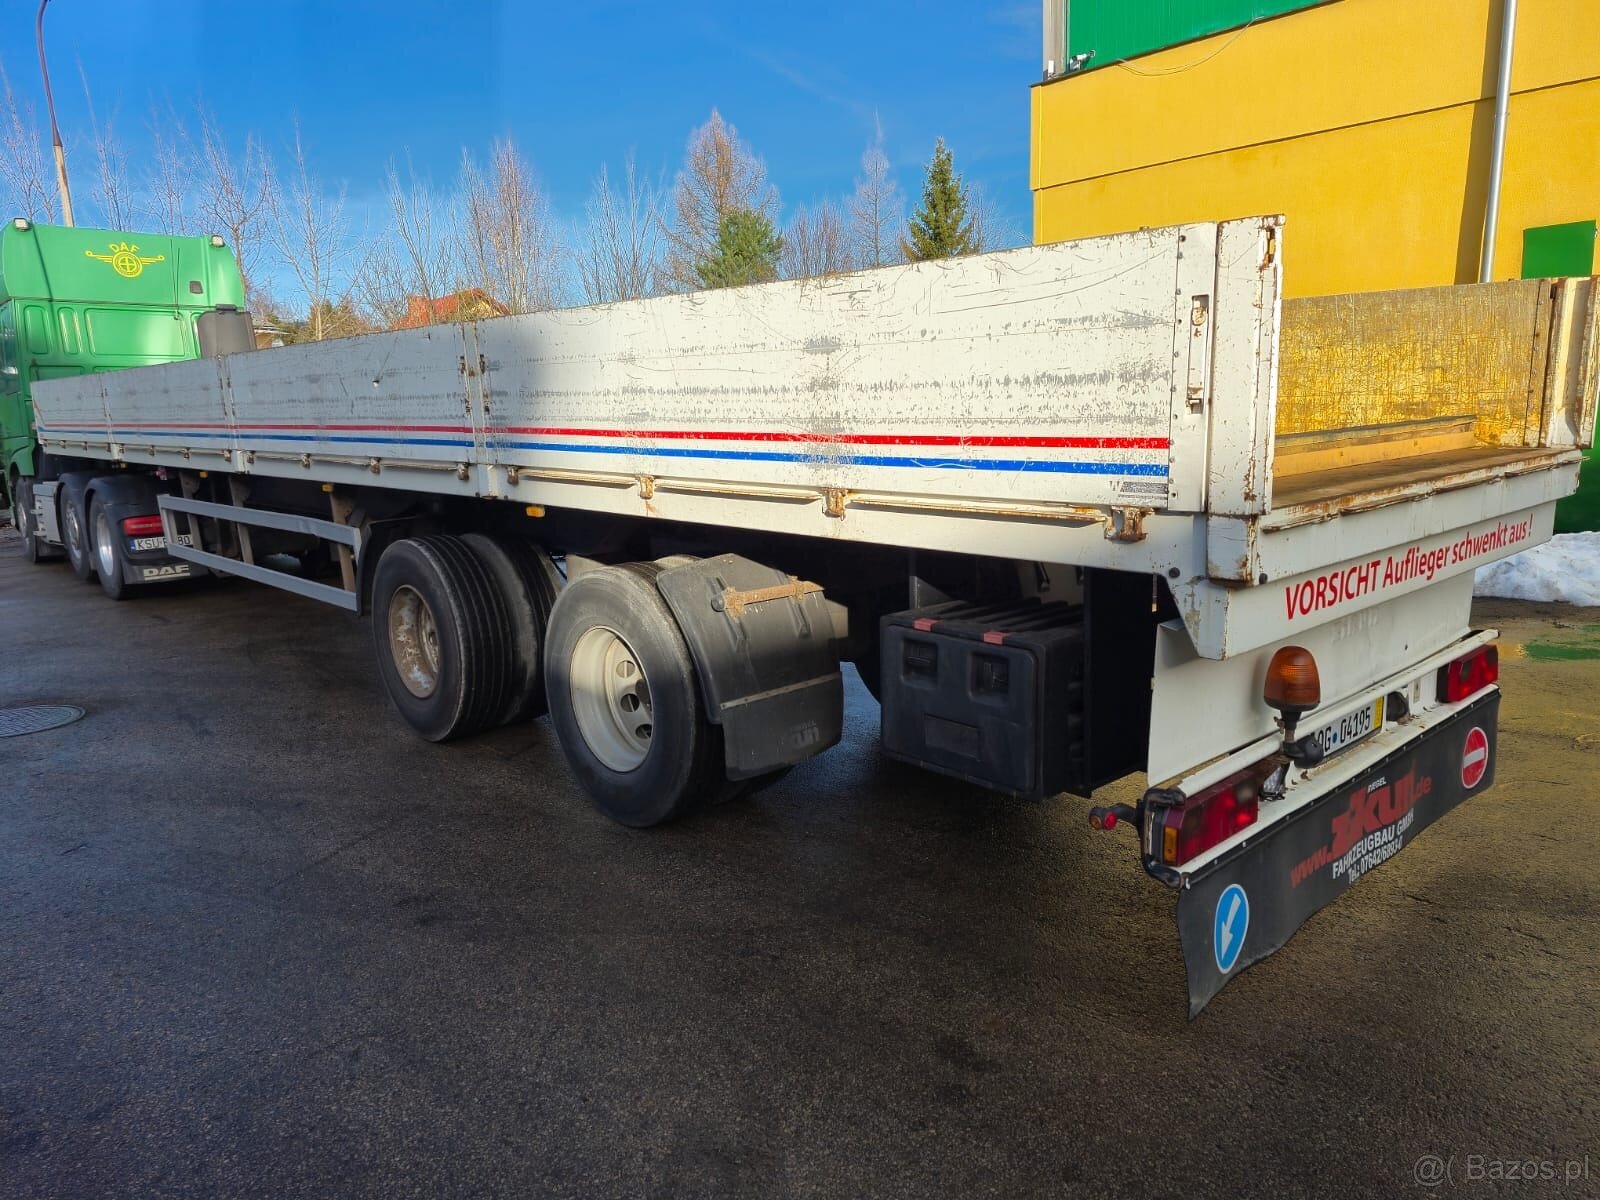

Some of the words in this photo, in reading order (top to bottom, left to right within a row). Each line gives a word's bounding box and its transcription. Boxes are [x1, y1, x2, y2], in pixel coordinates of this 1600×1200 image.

[109, 242, 140, 253] DAF
[143, 564, 190, 577] DAF
[1285, 559, 1381, 621] VORSICHT
[1382, 546, 1450, 588] Auflieger
[1451, 521, 1508, 563] schwenkt
[1508, 519, 1527, 544] aus
[1340, 706, 1371, 744] 04195
[1332, 824, 1395, 879] FAHRZEUGBAU
